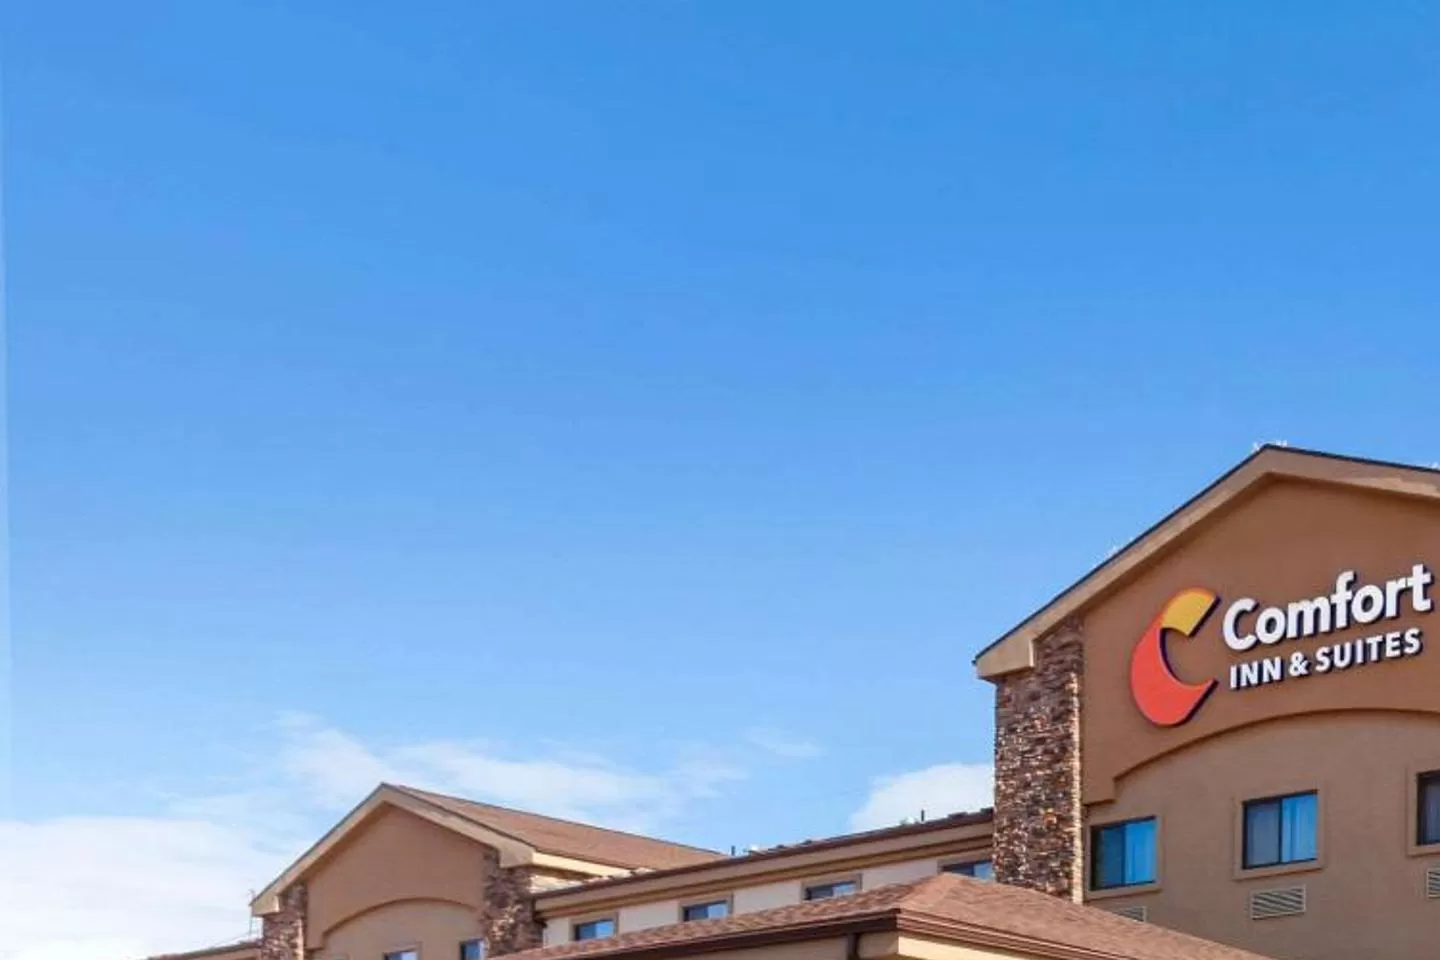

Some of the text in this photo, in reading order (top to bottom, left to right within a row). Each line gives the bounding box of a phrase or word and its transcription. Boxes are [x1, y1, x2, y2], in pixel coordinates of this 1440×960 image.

[1222, 563, 1433, 651] Comfort
[1229, 628, 1422, 690] INN & SUITES
